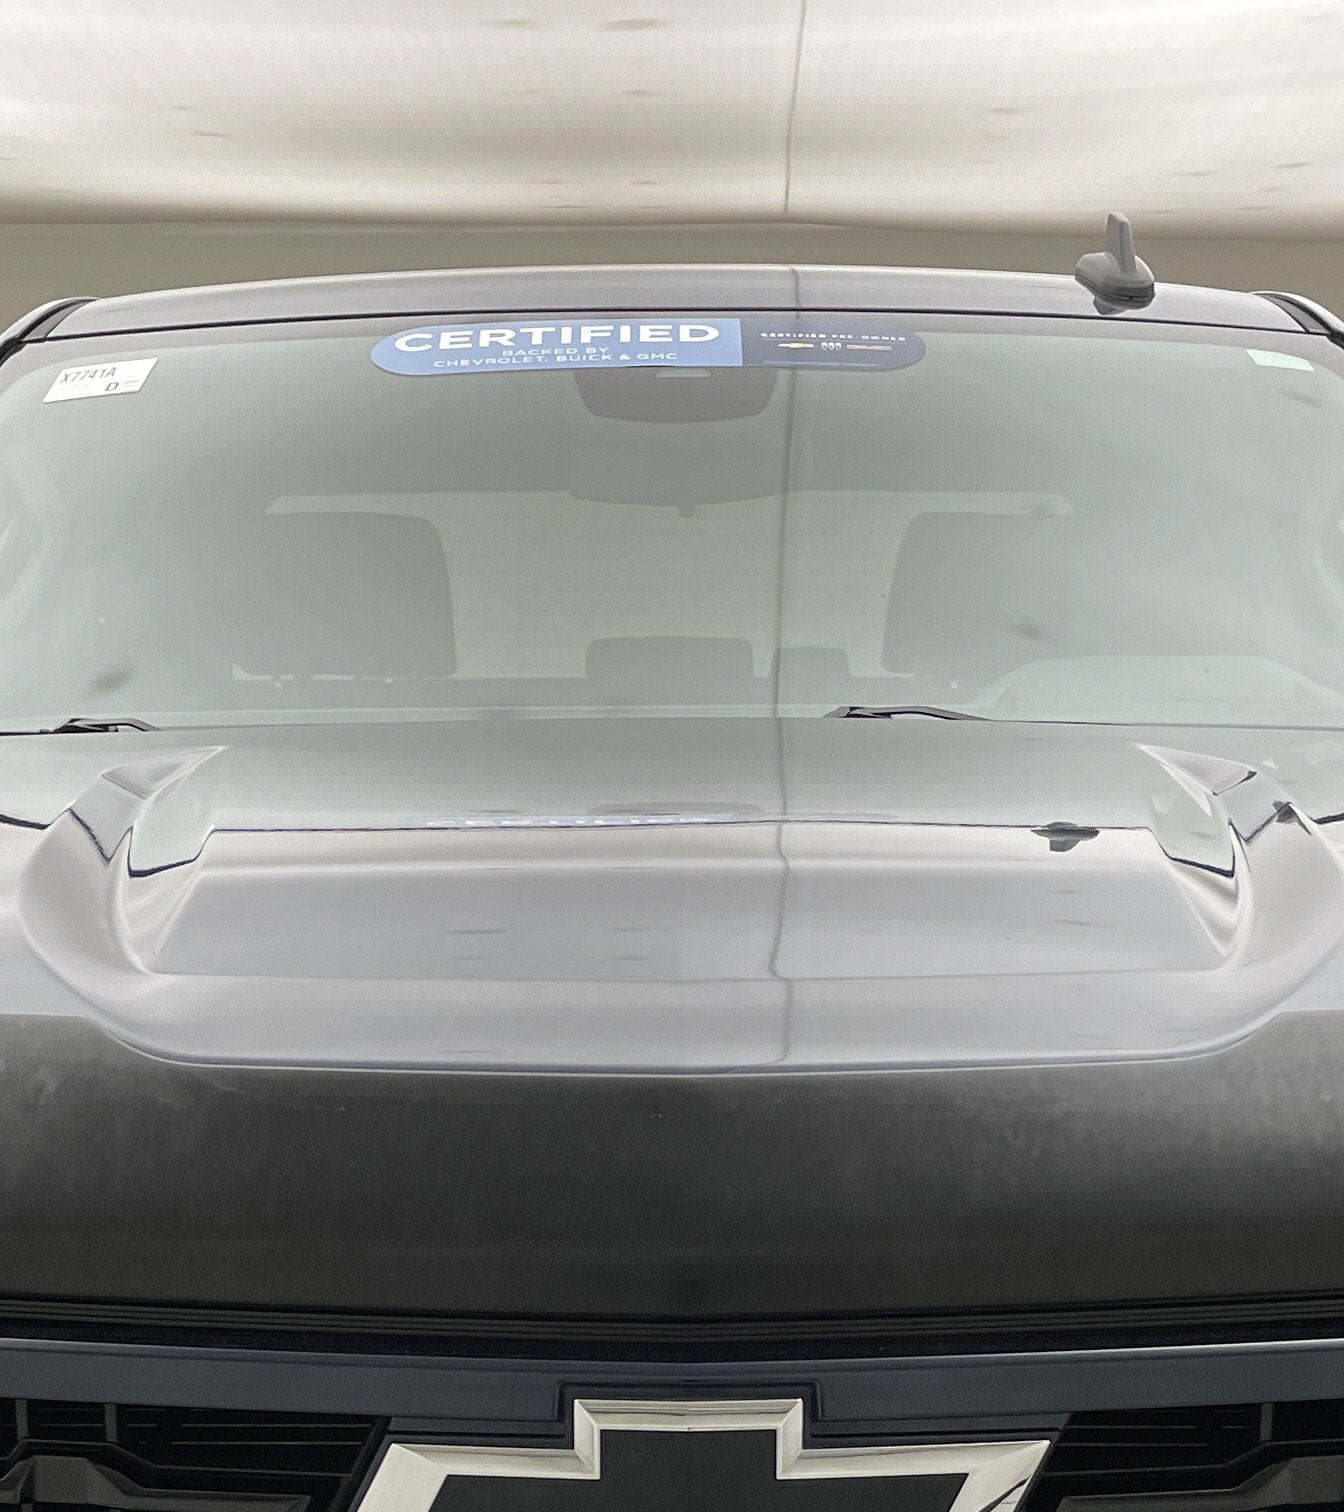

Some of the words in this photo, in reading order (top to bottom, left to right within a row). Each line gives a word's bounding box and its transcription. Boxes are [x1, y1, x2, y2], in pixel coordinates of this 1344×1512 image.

[394, 324, 721, 352] CERTIFIED
[502, 347, 578, 357] BACKED
[586, 346, 610, 355] BY
[556, 354, 612, 362] BUICK
[619, 353, 630, 361] &
[636, 352, 679, 361] GMC
